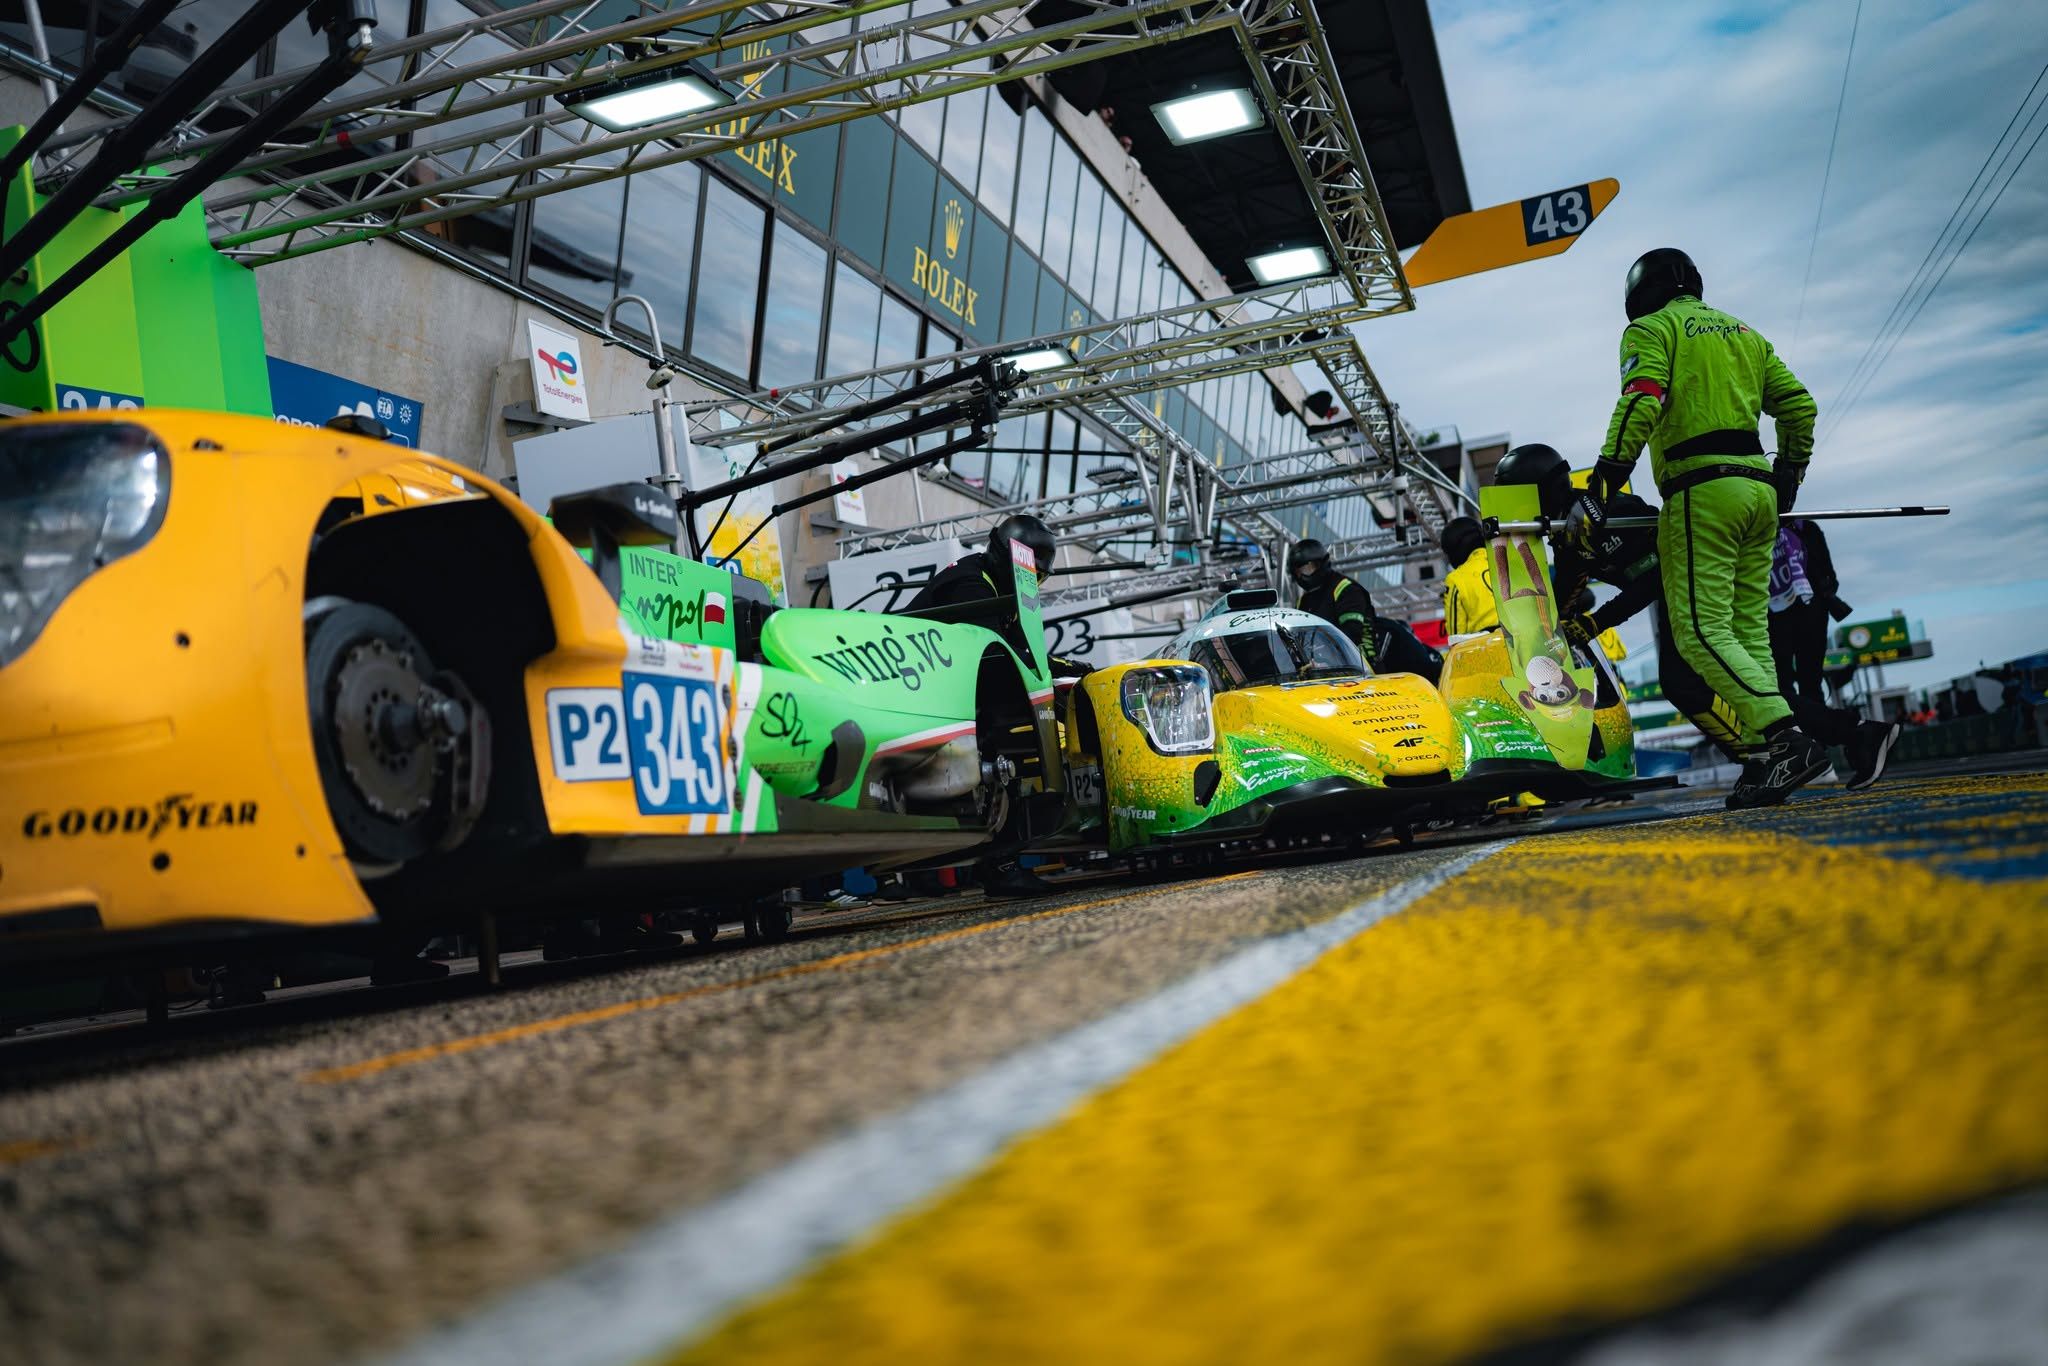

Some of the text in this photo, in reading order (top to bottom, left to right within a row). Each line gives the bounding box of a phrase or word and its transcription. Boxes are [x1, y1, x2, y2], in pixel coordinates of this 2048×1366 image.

[1531, 190, 1587, 238] 43
[911, 245, 978, 327] ROLEX
[543, 383, 583, 404] TotalEnergies
[629, 552, 679, 587] INTER
[811, 624, 953, 692] wing.vc
[1043, 618, 1095, 656] 23
[558, 703, 623, 766] P2
[632, 682, 723, 807] 343
[1393, 737, 1425, 748] 4F
[1404, 753, 1441, 762] ORECA
[1076, 774, 1092, 801] P2
[22, 793, 258, 841] GOODYEAR
